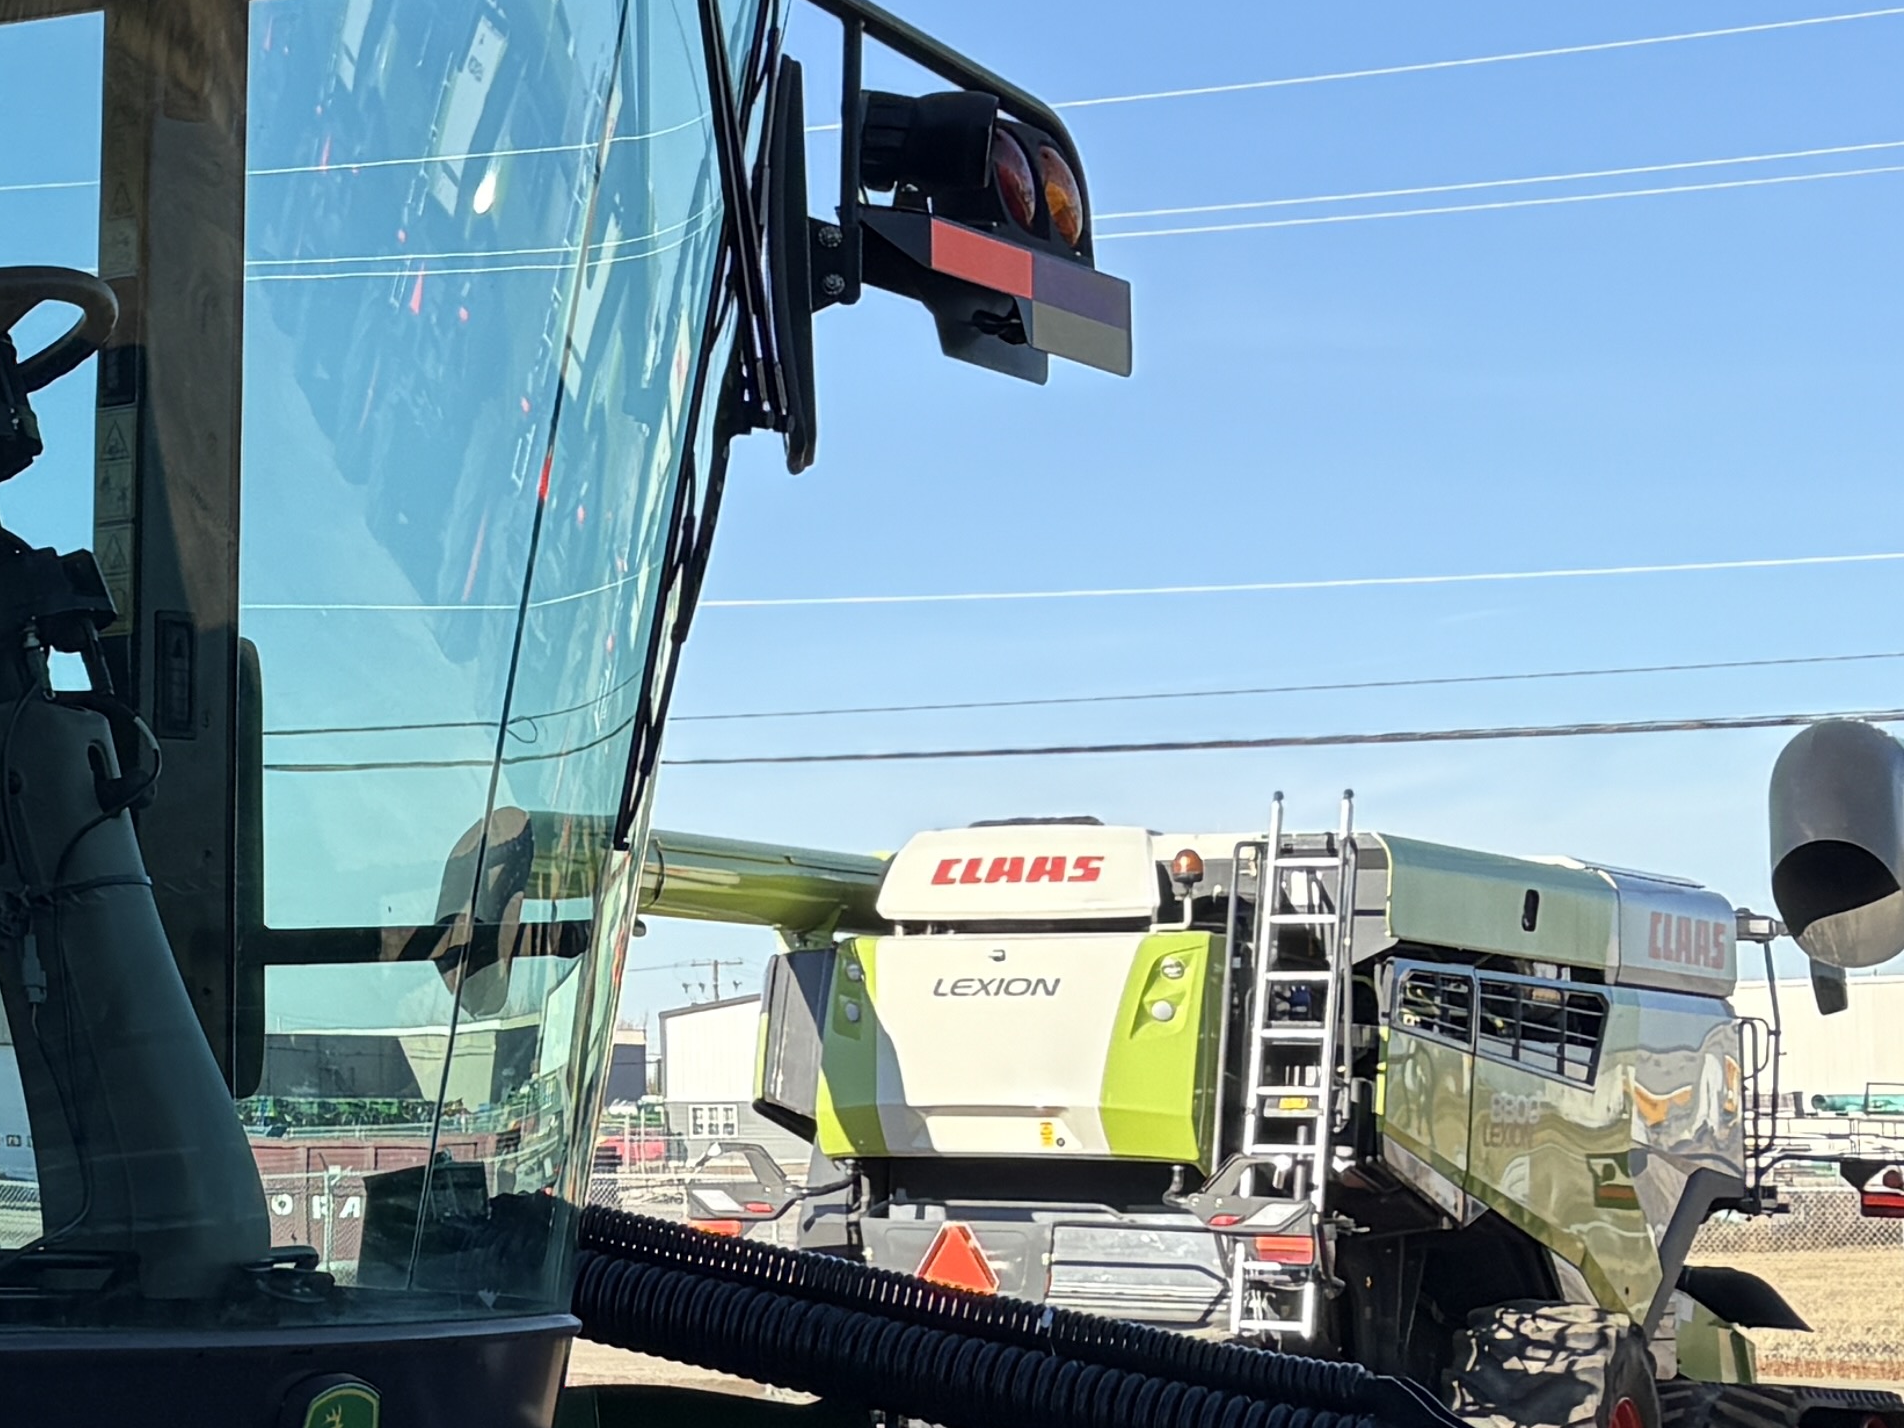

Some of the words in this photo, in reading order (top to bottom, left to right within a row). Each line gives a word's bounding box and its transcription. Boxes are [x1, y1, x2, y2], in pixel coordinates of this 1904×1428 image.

[930, 855, 1105, 885] CLAAS
[1648, 911, 1727, 970] CLAAS
[933, 977, 1061, 997] LEXION
